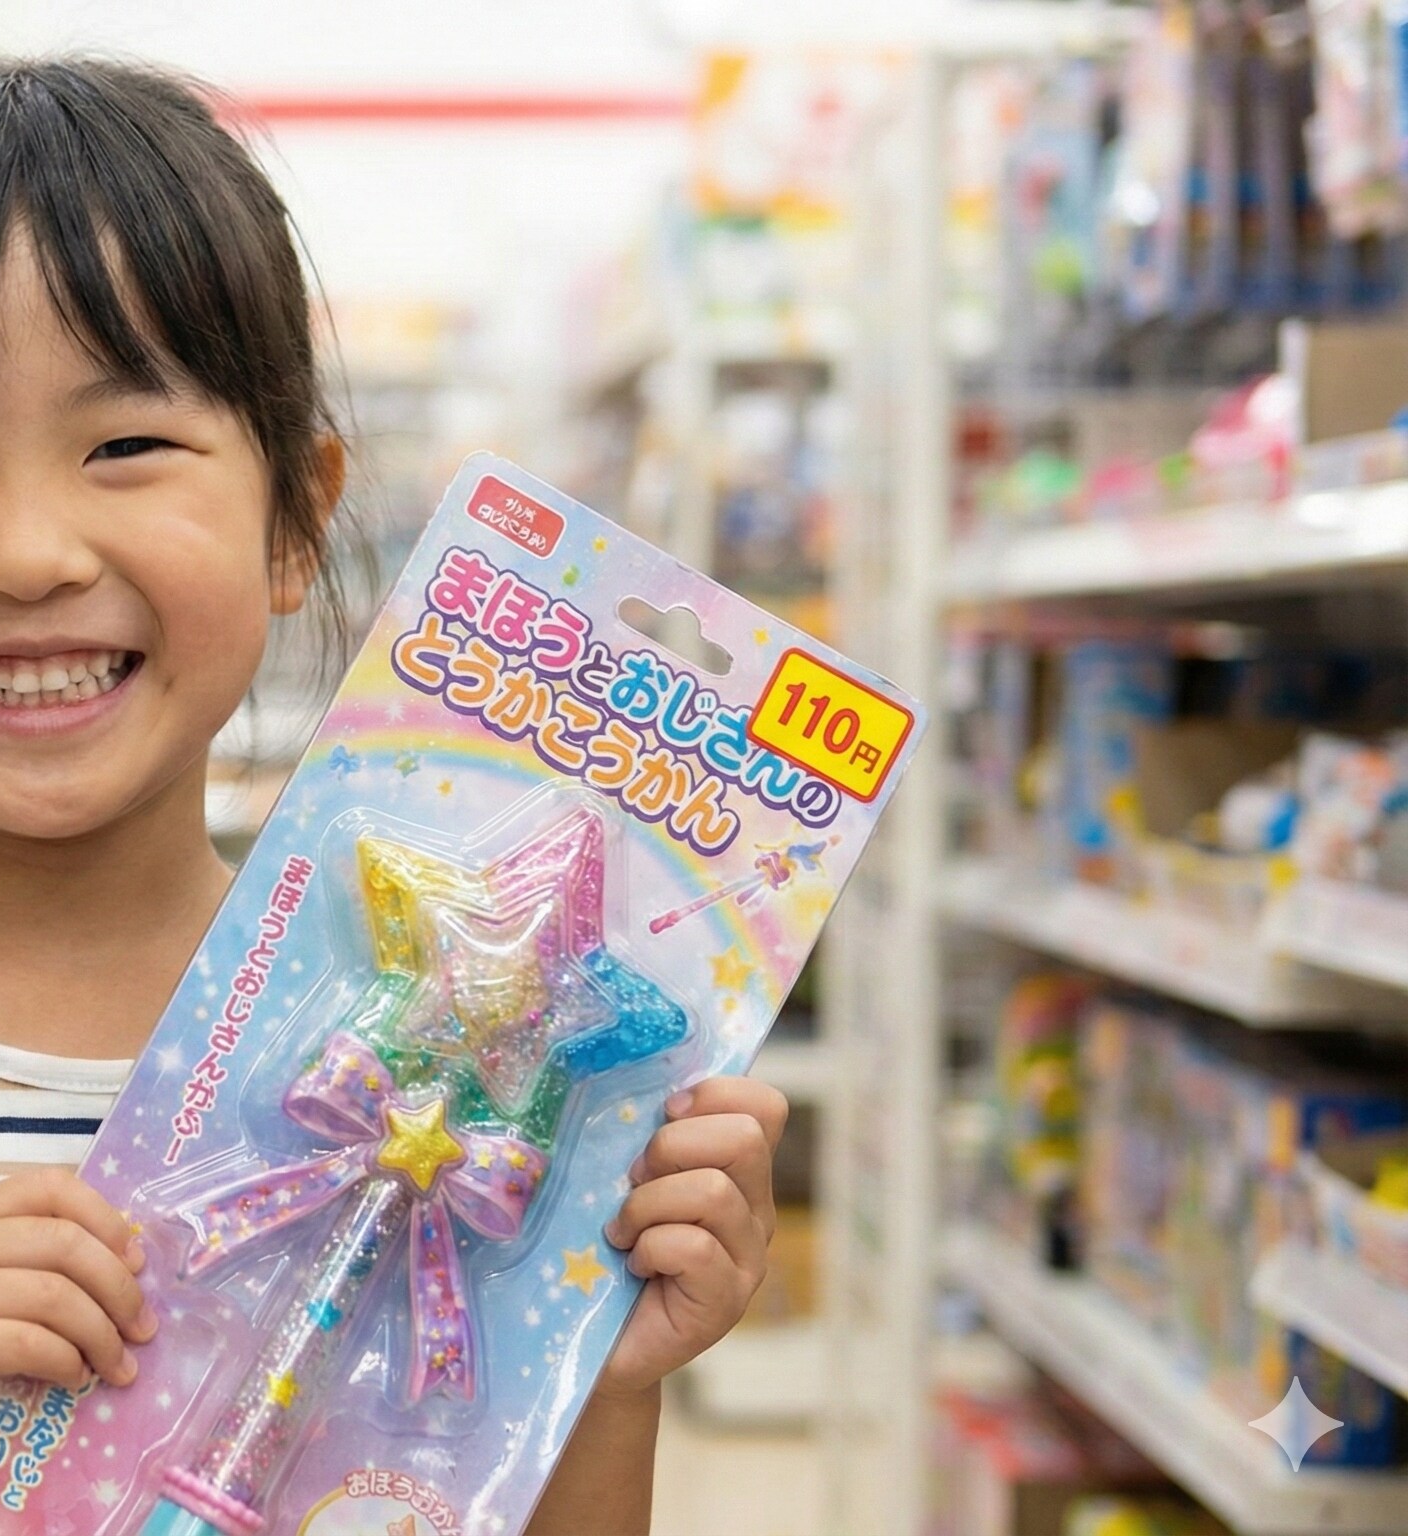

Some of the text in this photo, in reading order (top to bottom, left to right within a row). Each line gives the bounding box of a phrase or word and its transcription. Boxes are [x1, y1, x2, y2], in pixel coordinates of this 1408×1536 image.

[397, 614, 735, 846] とうかこうかん
[430, 550, 836, 818] まほうとおじさんの
[777, 681, 883, 775] 110円
